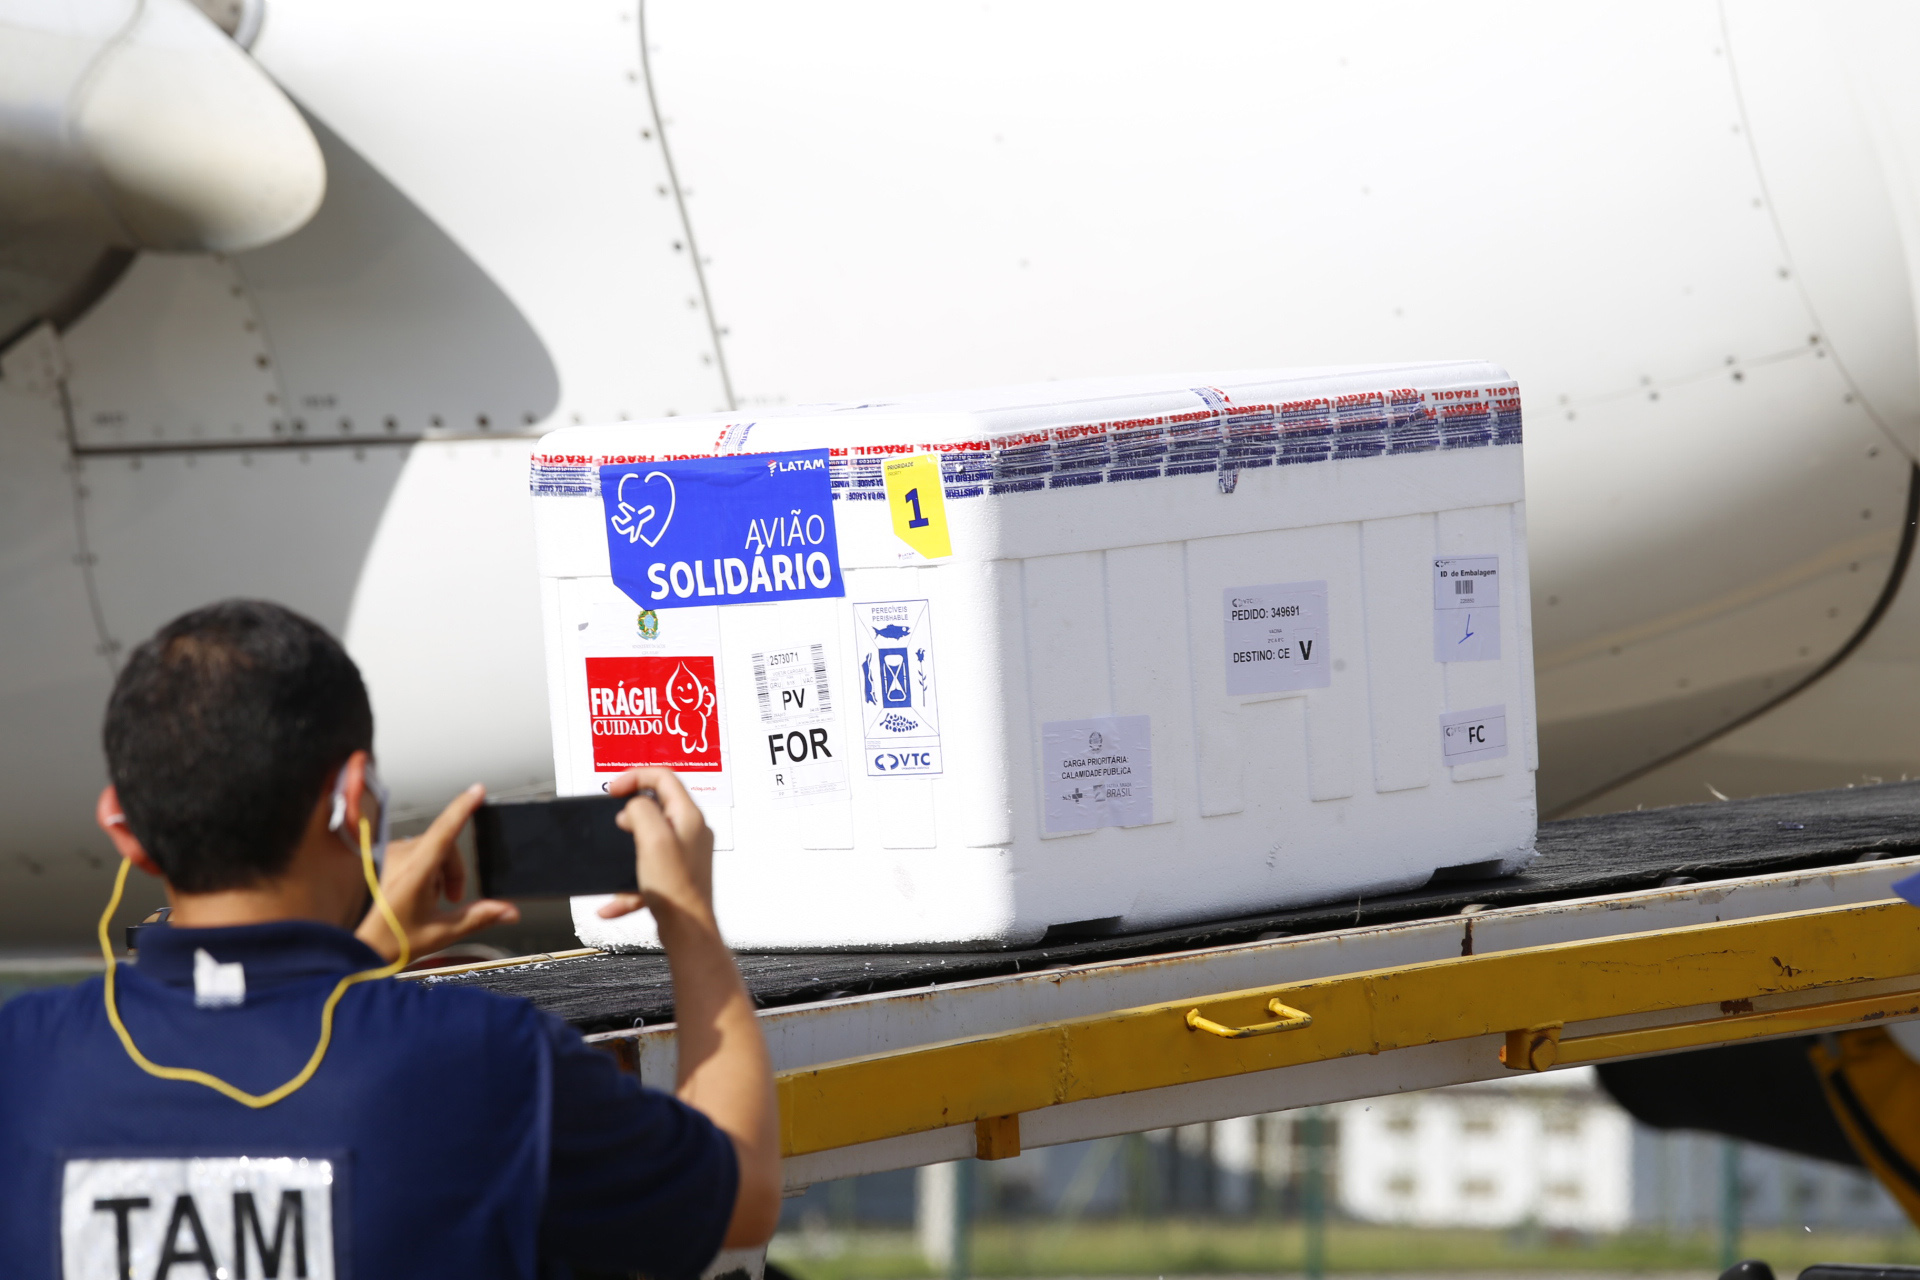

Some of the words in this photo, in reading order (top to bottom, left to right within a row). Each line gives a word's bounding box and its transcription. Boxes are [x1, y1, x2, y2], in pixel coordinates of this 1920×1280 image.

[779, 459, 826, 472] LATAM
[905, 488, 929, 529] 1
[745, 509, 825, 550] AVIÃO
[648, 544, 832, 600] SOLIDÁRIO
[1460, 569, 1497, 577] Embalagem
[871, 605, 908, 614] PERECÍVEIS
[1232, 608, 1268, 621] PEDIDO:
[1271, 605, 1300, 618] 349691
[872, 614, 909, 622] PERISHABLE
[1233, 649, 1275, 663] DESTINO:
[1278, 648, 1290, 659] CE
[1299, 640, 1313, 661] V
[769, 652, 799, 666] 2573071
[590, 680, 662, 716] FRÁGIL
[782, 688, 805, 711] PV
[592, 719, 663, 736] CUIDADO
[1468, 724, 1486, 744] FC
[768, 727, 833, 766] FOR
[899, 752, 931, 767] VTC
[1063, 760, 1087, 768] CARGA
[775, 774, 785, 786] R
[1061, 769, 1102, 780] CALAMIDADE
[1106, 788, 1133, 798] BRASIL
[93, 1190, 306, 1280] TAM
